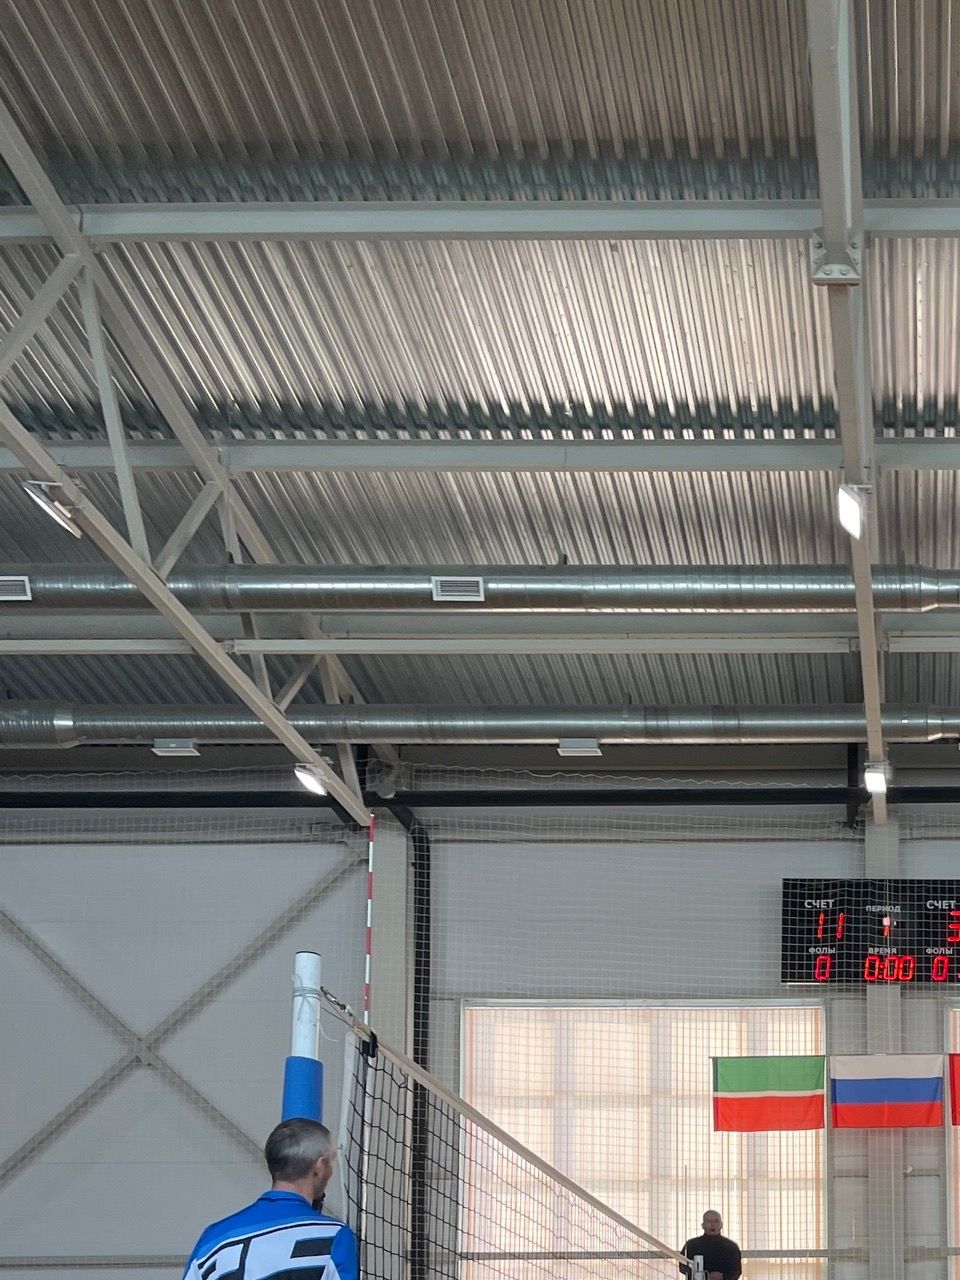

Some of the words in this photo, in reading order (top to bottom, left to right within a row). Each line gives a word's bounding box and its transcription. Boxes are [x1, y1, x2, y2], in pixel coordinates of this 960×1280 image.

[804, 899, 835, 909] СЧЕТ
[865, 905, 901, 913] ПЕРИОД
[926, 900, 957, 910] СЧЕТ
[817, 911, 845, 939] 11
[808, 946, 836, 955] ФОЛЫ
[925, 947, 953, 955] ФОЛЫ
[815, 954, 832, 981] 0
